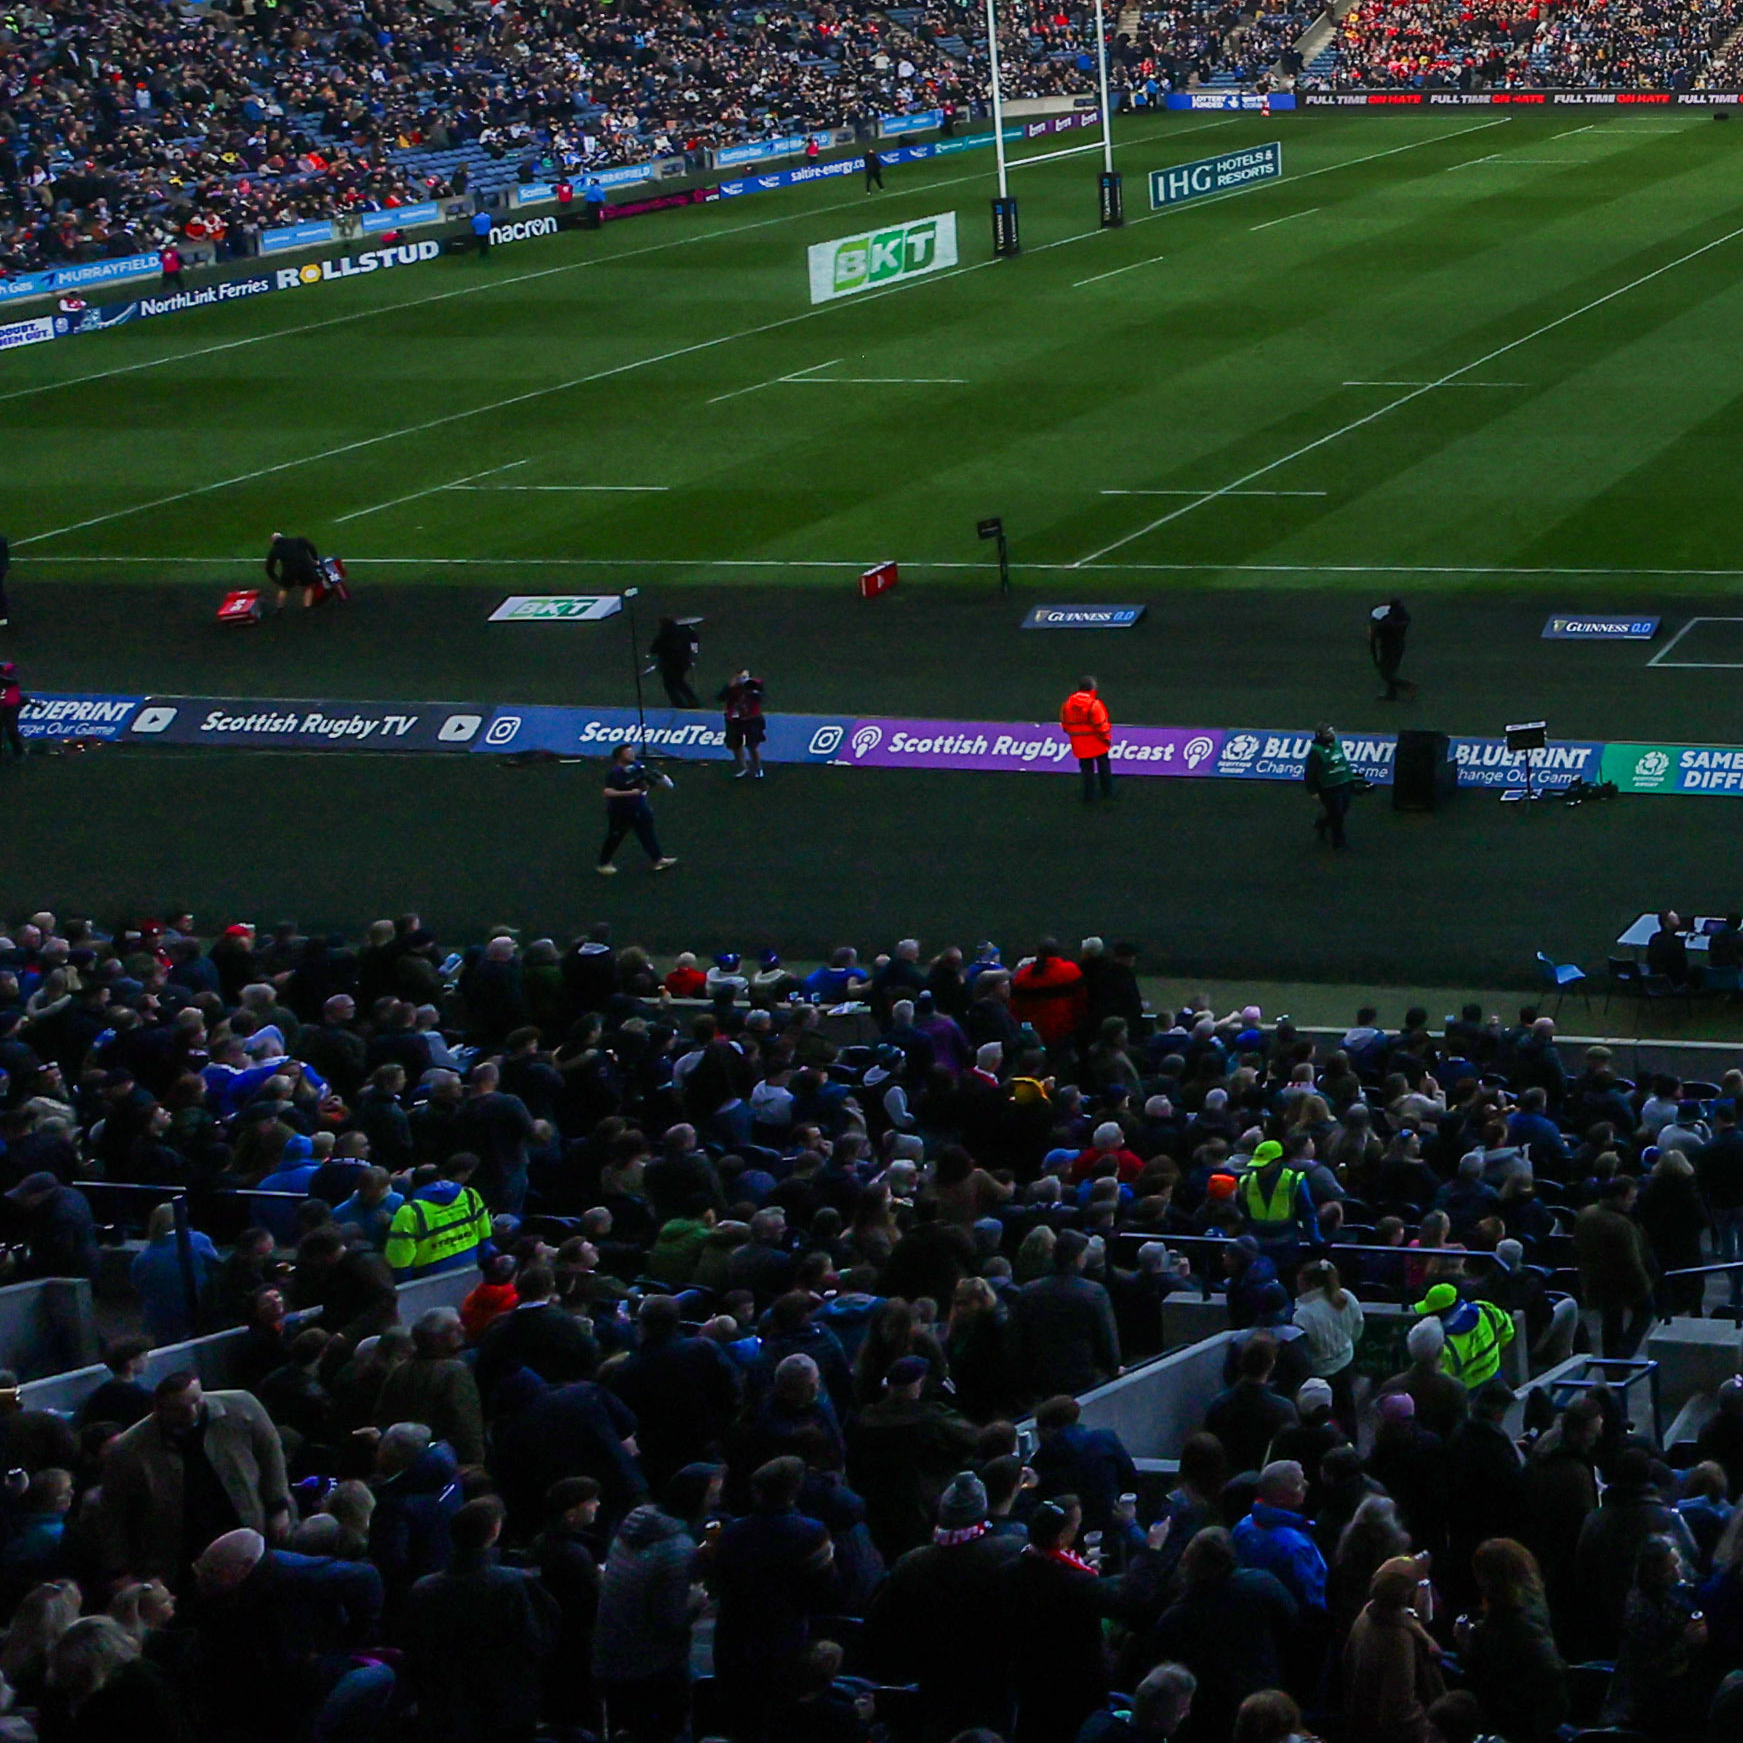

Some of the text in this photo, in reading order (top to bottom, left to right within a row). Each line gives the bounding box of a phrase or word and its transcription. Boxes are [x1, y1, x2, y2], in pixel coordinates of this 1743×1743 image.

[1306, 95, 1422, 105] FULL TIME ON HATE
[791, 159, 866, 182] saltire-energy.co
[1217, 149, 1273, 172] HOTELS &
[586, 166, 650, 186] MRRAYFIELD
[1158, 165, 1210, 202] IHG
[1217, 163, 1275, 187] RESORTS
[276, 240, 440, 290] ROLLSTUD
[835, 225, 938, 287] BKT
[57, 256, 160, 285] MURRAYFIELD
[141, 278, 269, 317] NorthLink Ferries
[514, 600, 591, 616] BKT
[1048, 611, 1135, 622] GUINNESS 0.0
[1566, 622, 1651, 633] GUINNESS 0.0
[19, 700, 137, 723] LUEPRINT
[47, 722, 76, 737] Our
[78, 723, 117, 737] Game
[200, 710, 419, 739] Scottish Rugby TV
[888, 732, 1175, 763] Scottish Rugby dcast
[1264, 736, 1397, 763] BLURINT
[1455, 743, 1593, 770] BLUEPRINT
[1256, 760, 1305, 778] Chang
[1457, 769, 1581, 784] hange Our Game
